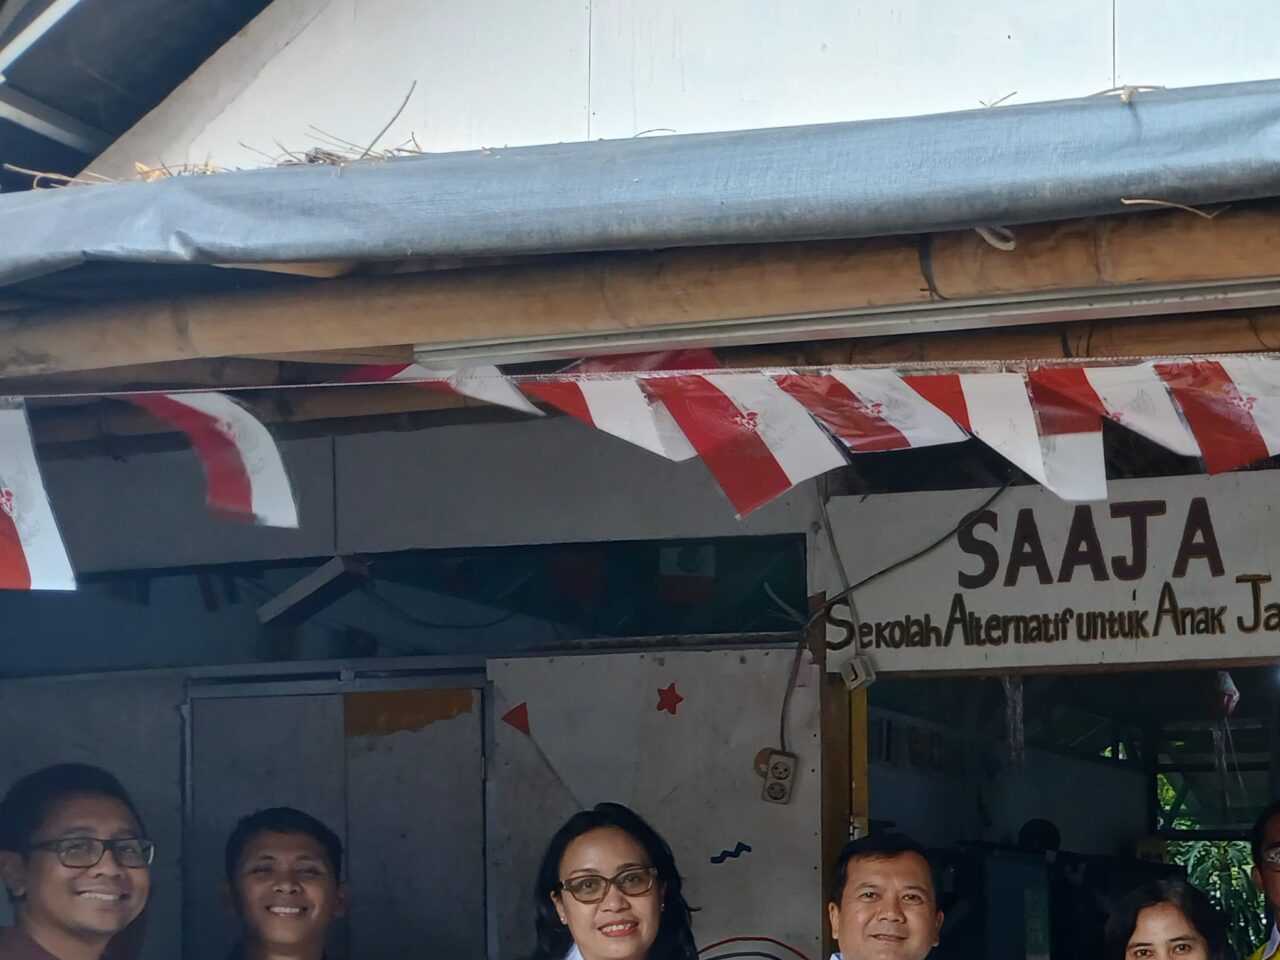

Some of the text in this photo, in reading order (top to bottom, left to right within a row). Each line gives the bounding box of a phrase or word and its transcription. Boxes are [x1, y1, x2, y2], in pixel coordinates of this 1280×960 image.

[957, 497, 1226, 590] SAAJA
[825, 595, 949, 651] Sekolah
[943, 593, 1085, 646] Alternatif
[1075, 608, 1150, 642] untuk
[1152, 580, 1227, 637] Anak
